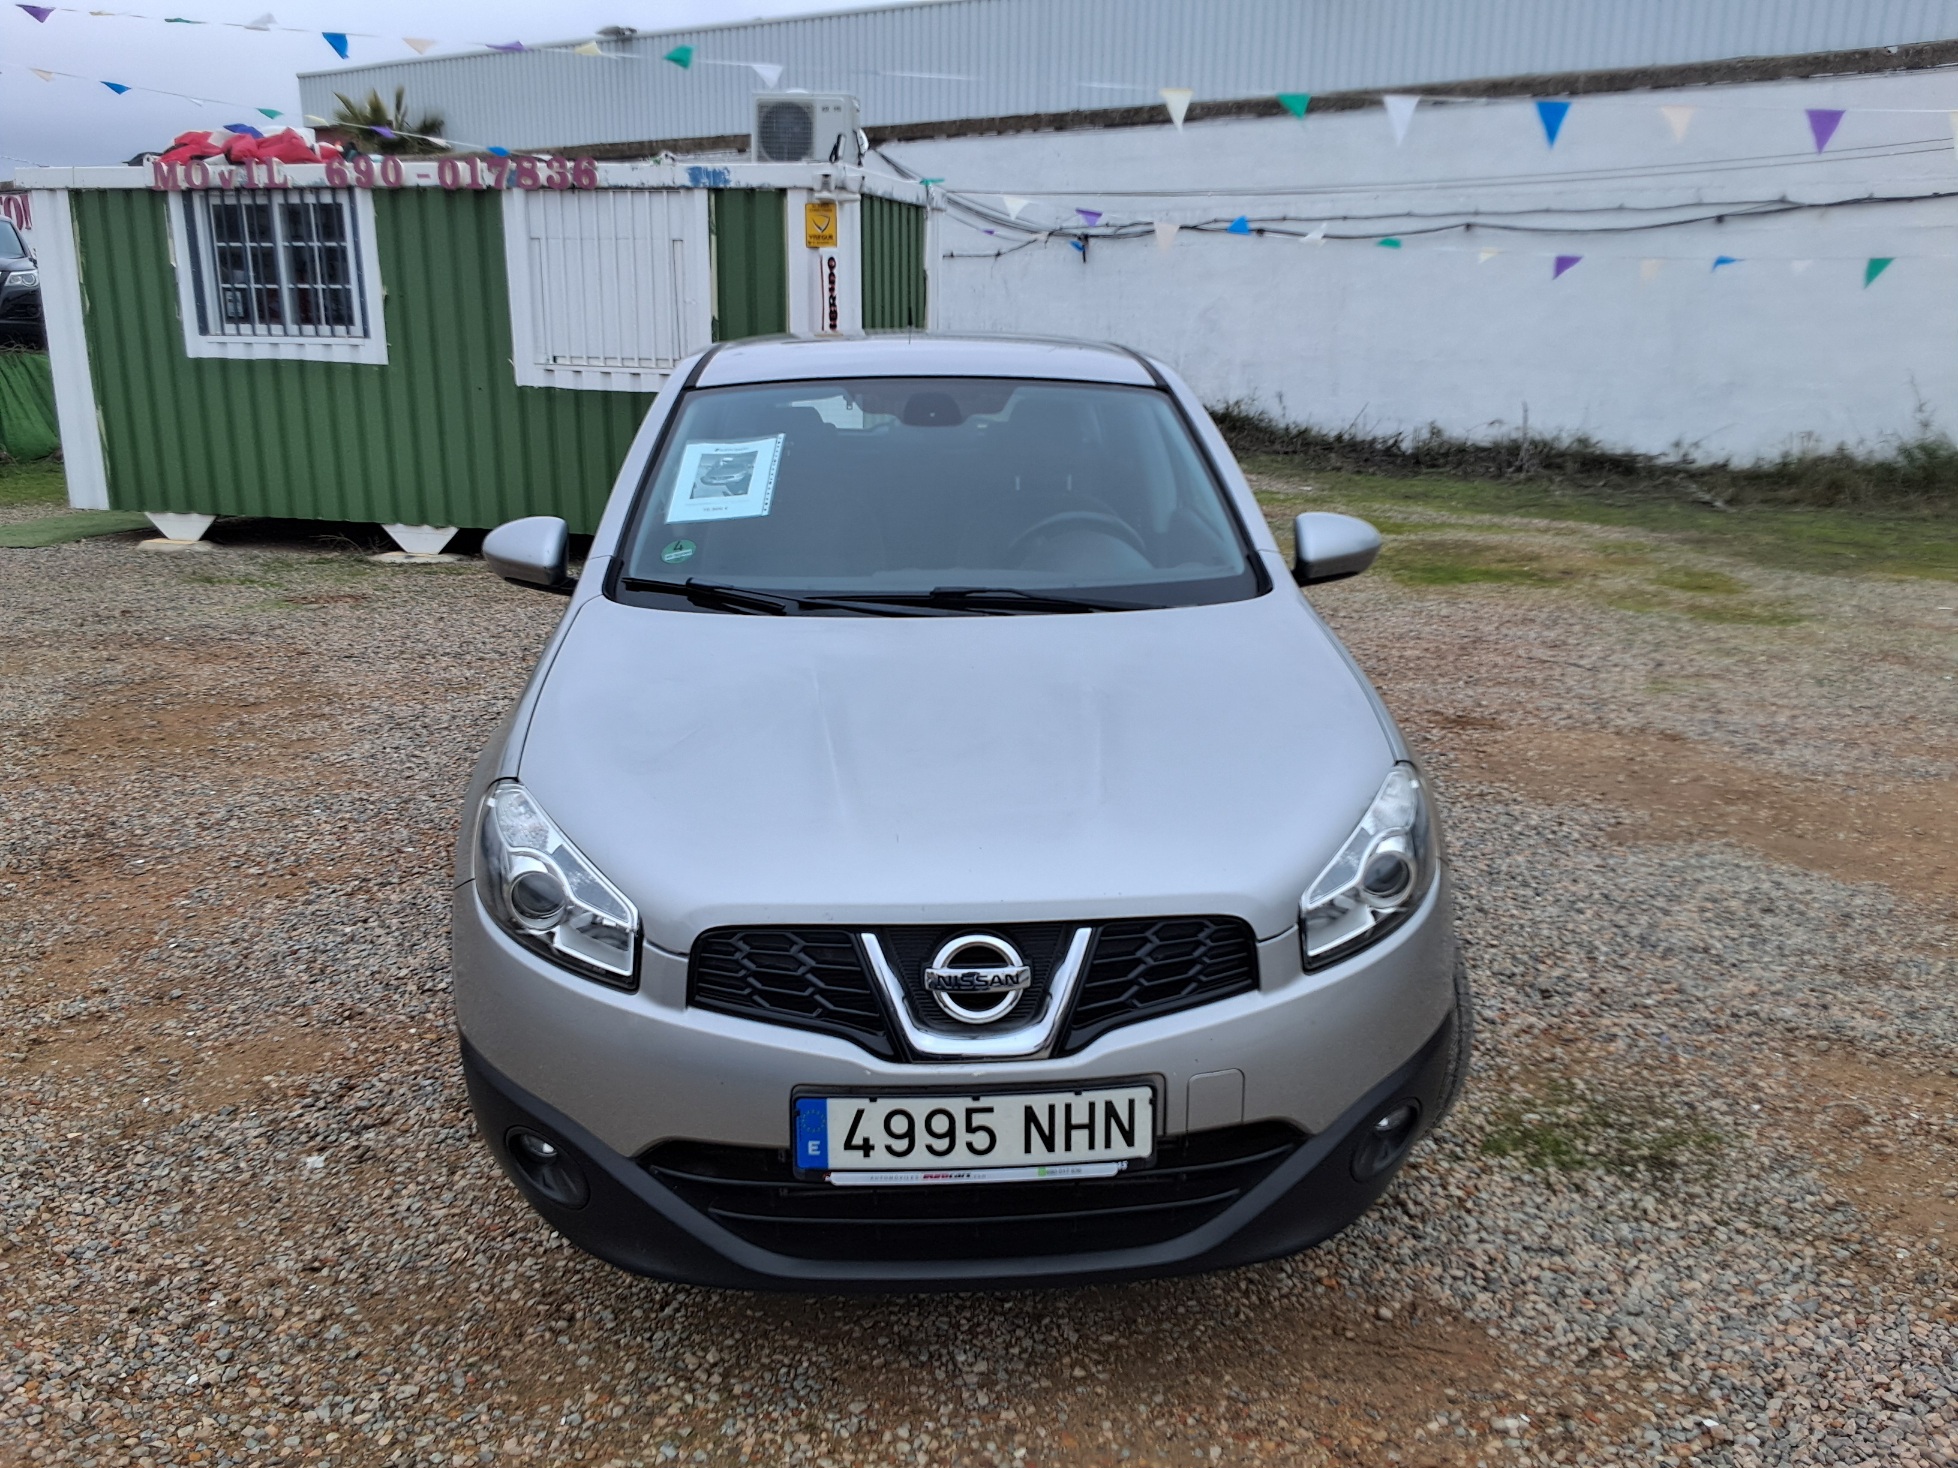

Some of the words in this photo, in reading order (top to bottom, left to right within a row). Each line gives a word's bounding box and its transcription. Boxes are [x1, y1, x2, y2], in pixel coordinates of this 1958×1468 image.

[673, 540, 683, 551] 4
[937, 974, 1020, 988] NISSAN
[843, 1106, 997, 1158] 4995
[1024, 1098, 1136, 1154] NHN
[807, 1140, 821, 1156] E
